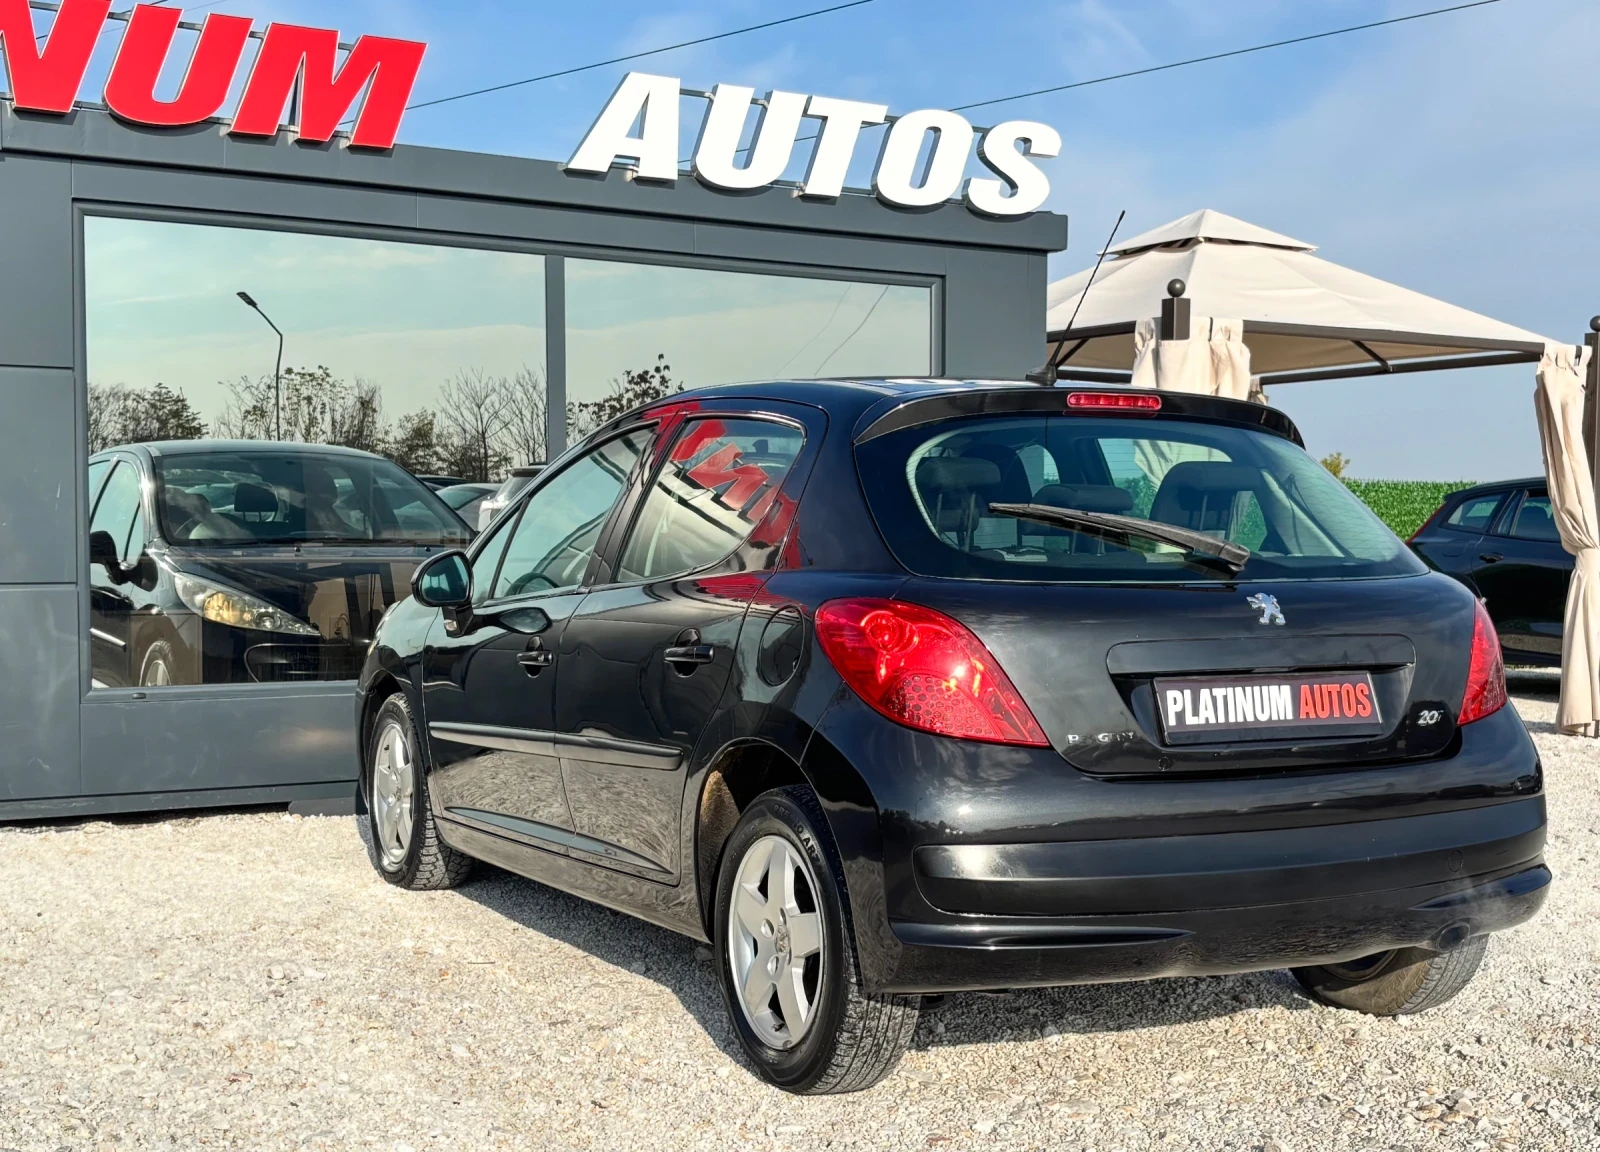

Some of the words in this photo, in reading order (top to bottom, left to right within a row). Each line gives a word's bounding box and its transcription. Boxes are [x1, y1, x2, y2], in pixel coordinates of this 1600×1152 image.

[562, 71, 1063, 216] AUTOS
[1165, 684, 1294, 727] PLATINUM
[1299, 682, 1373, 719] AUTOS
